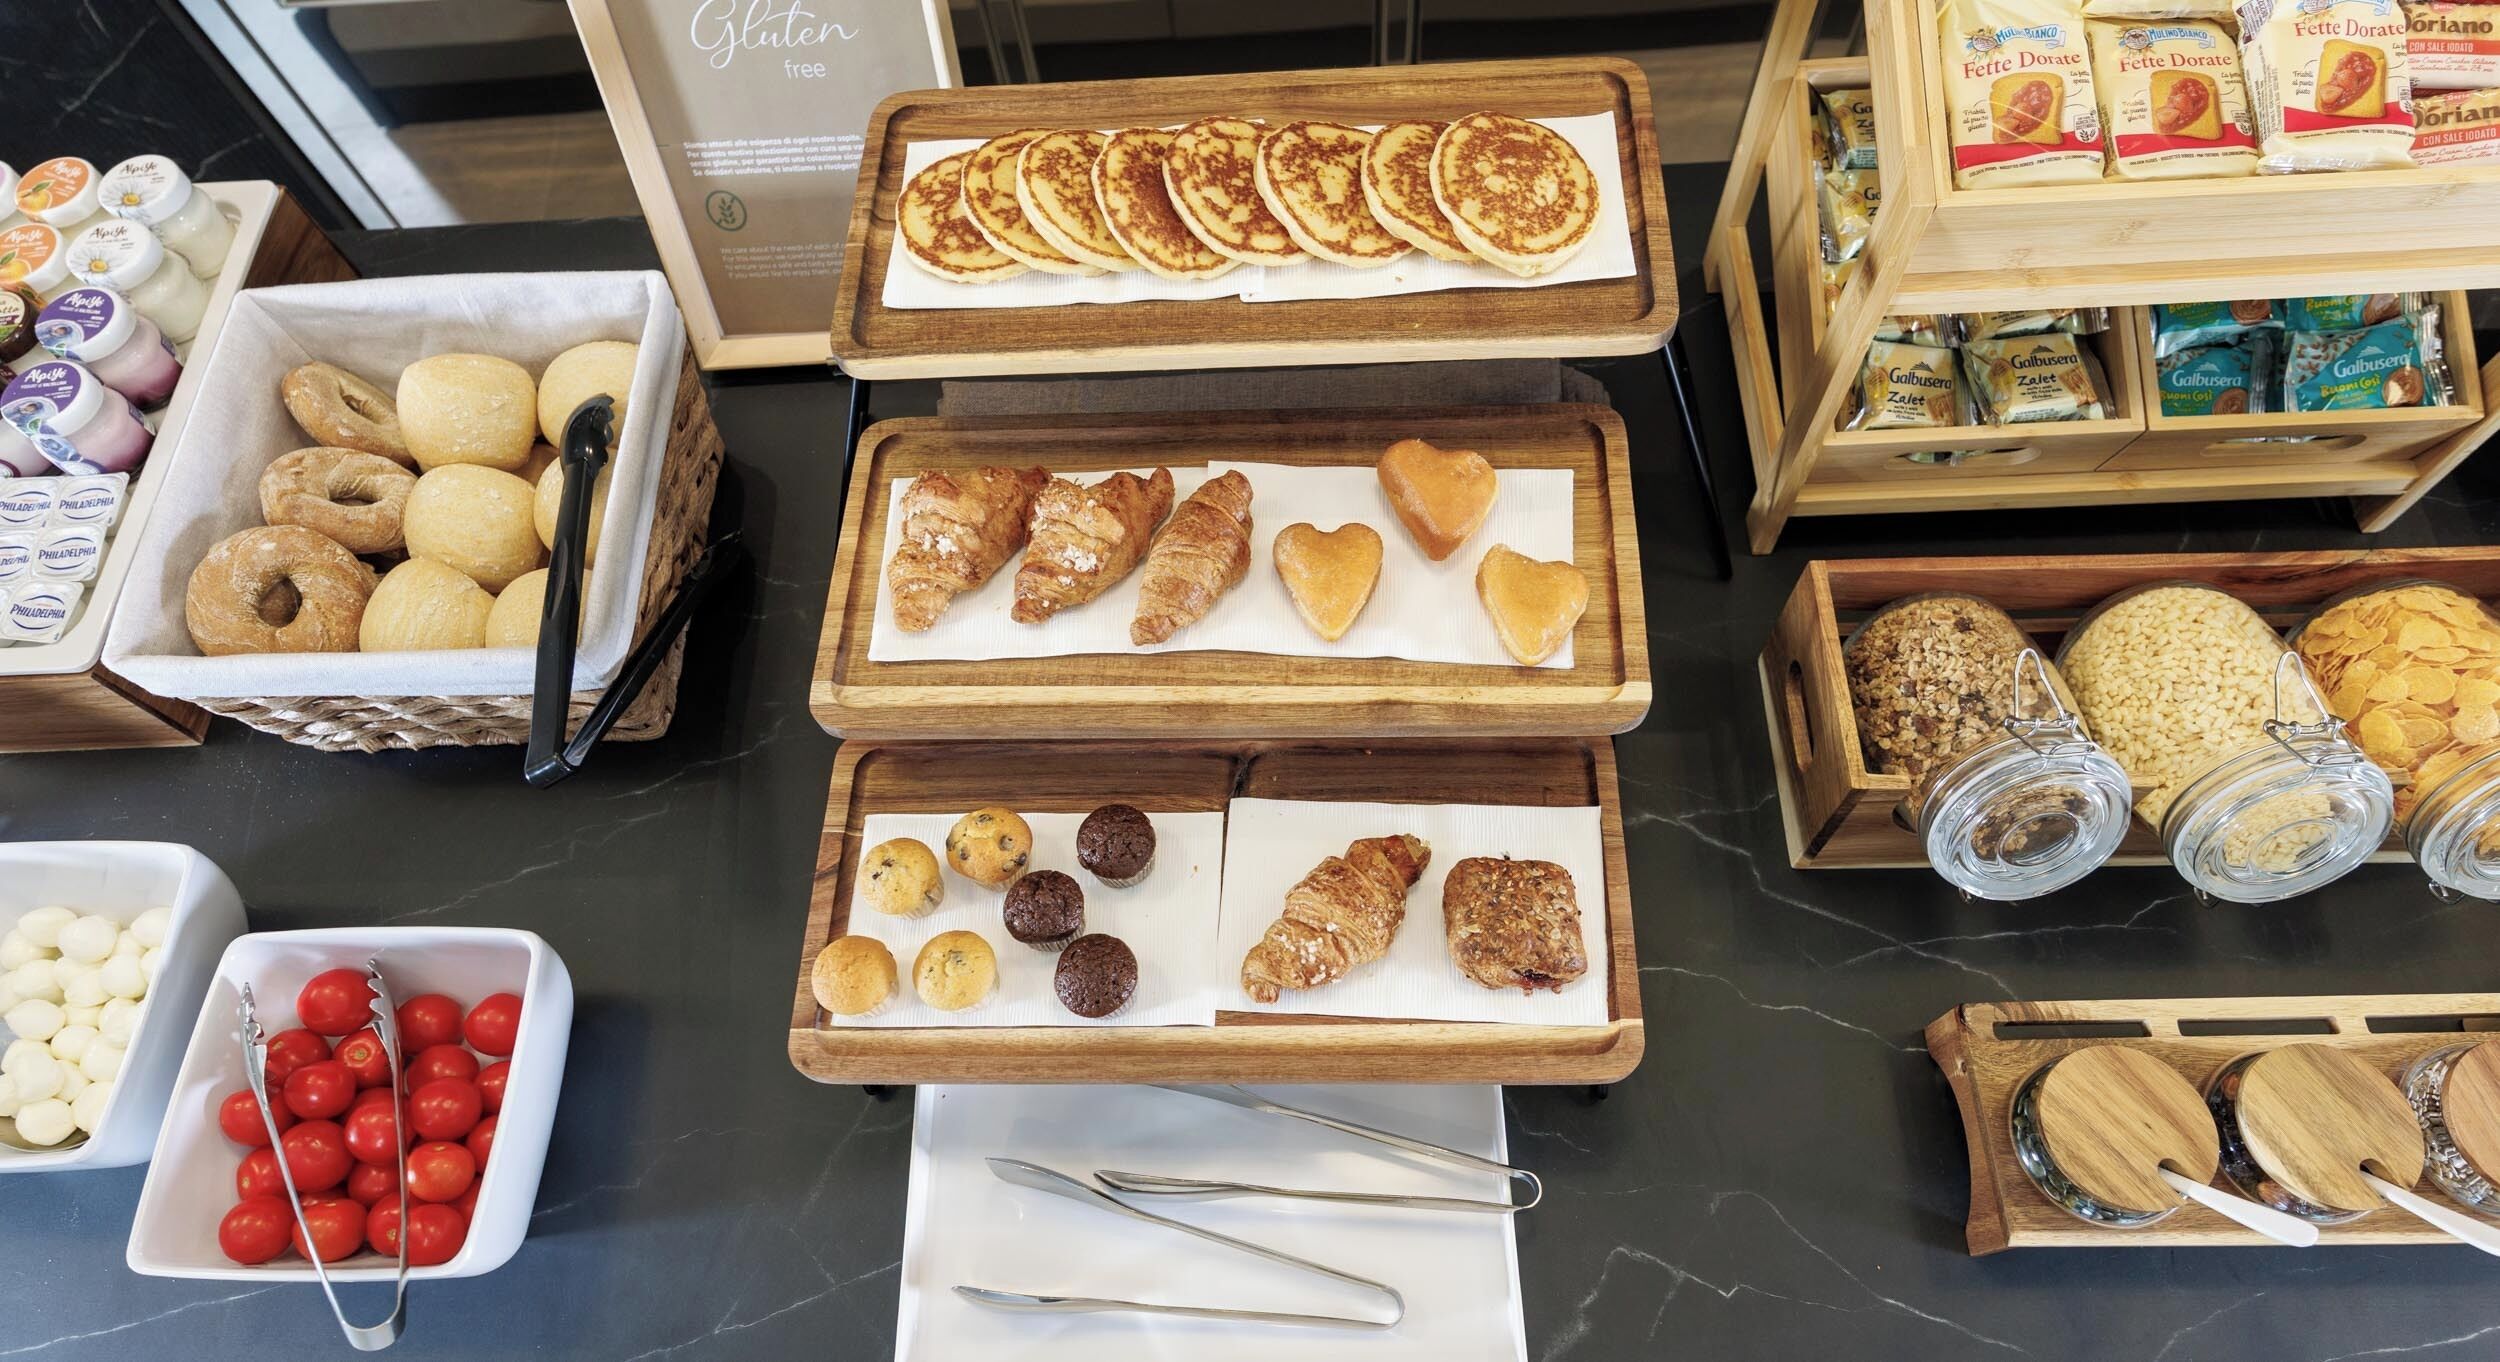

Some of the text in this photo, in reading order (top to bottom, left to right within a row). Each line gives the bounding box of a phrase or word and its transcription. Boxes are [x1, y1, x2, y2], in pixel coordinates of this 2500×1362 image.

[691, 0, 859, 69] Gluten
[2025, 26, 2058, 40] BIANCO
[2150, 28, 2208, 41] MULINO BIANCO
[2293, 19, 2404, 37] Fette Dorate
[2409, 42, 2425, 52] CON
[2427, 42, 2446, 52] SALE
[2447, 42, 2474, 53] IODATO
[784, 59, 826, 79] free
[1963, 51, 2081, 79] Fette Dorate
[2120, 53, 2232, 73] Fette Dorate
[2423, 127, 2497, 146] CON SALE IODATO
[2011, 353, 2079, 369] Galbusera
[2334, 353, 2409, 378] Galbusera
[1889, 367, 1952, 390] Galbusera
[2017, 373, 2057, 387] Zalet
[2172, 370, 2242, 387] Galbusera
[1887, 391, 1926, 406] Zalet
[60, 497, 114, 510] PHILADELPHIA
[39, 546, 97, 560] PHILADELPHIA
[10, 603, 66, 619] PHILADELPHIA
